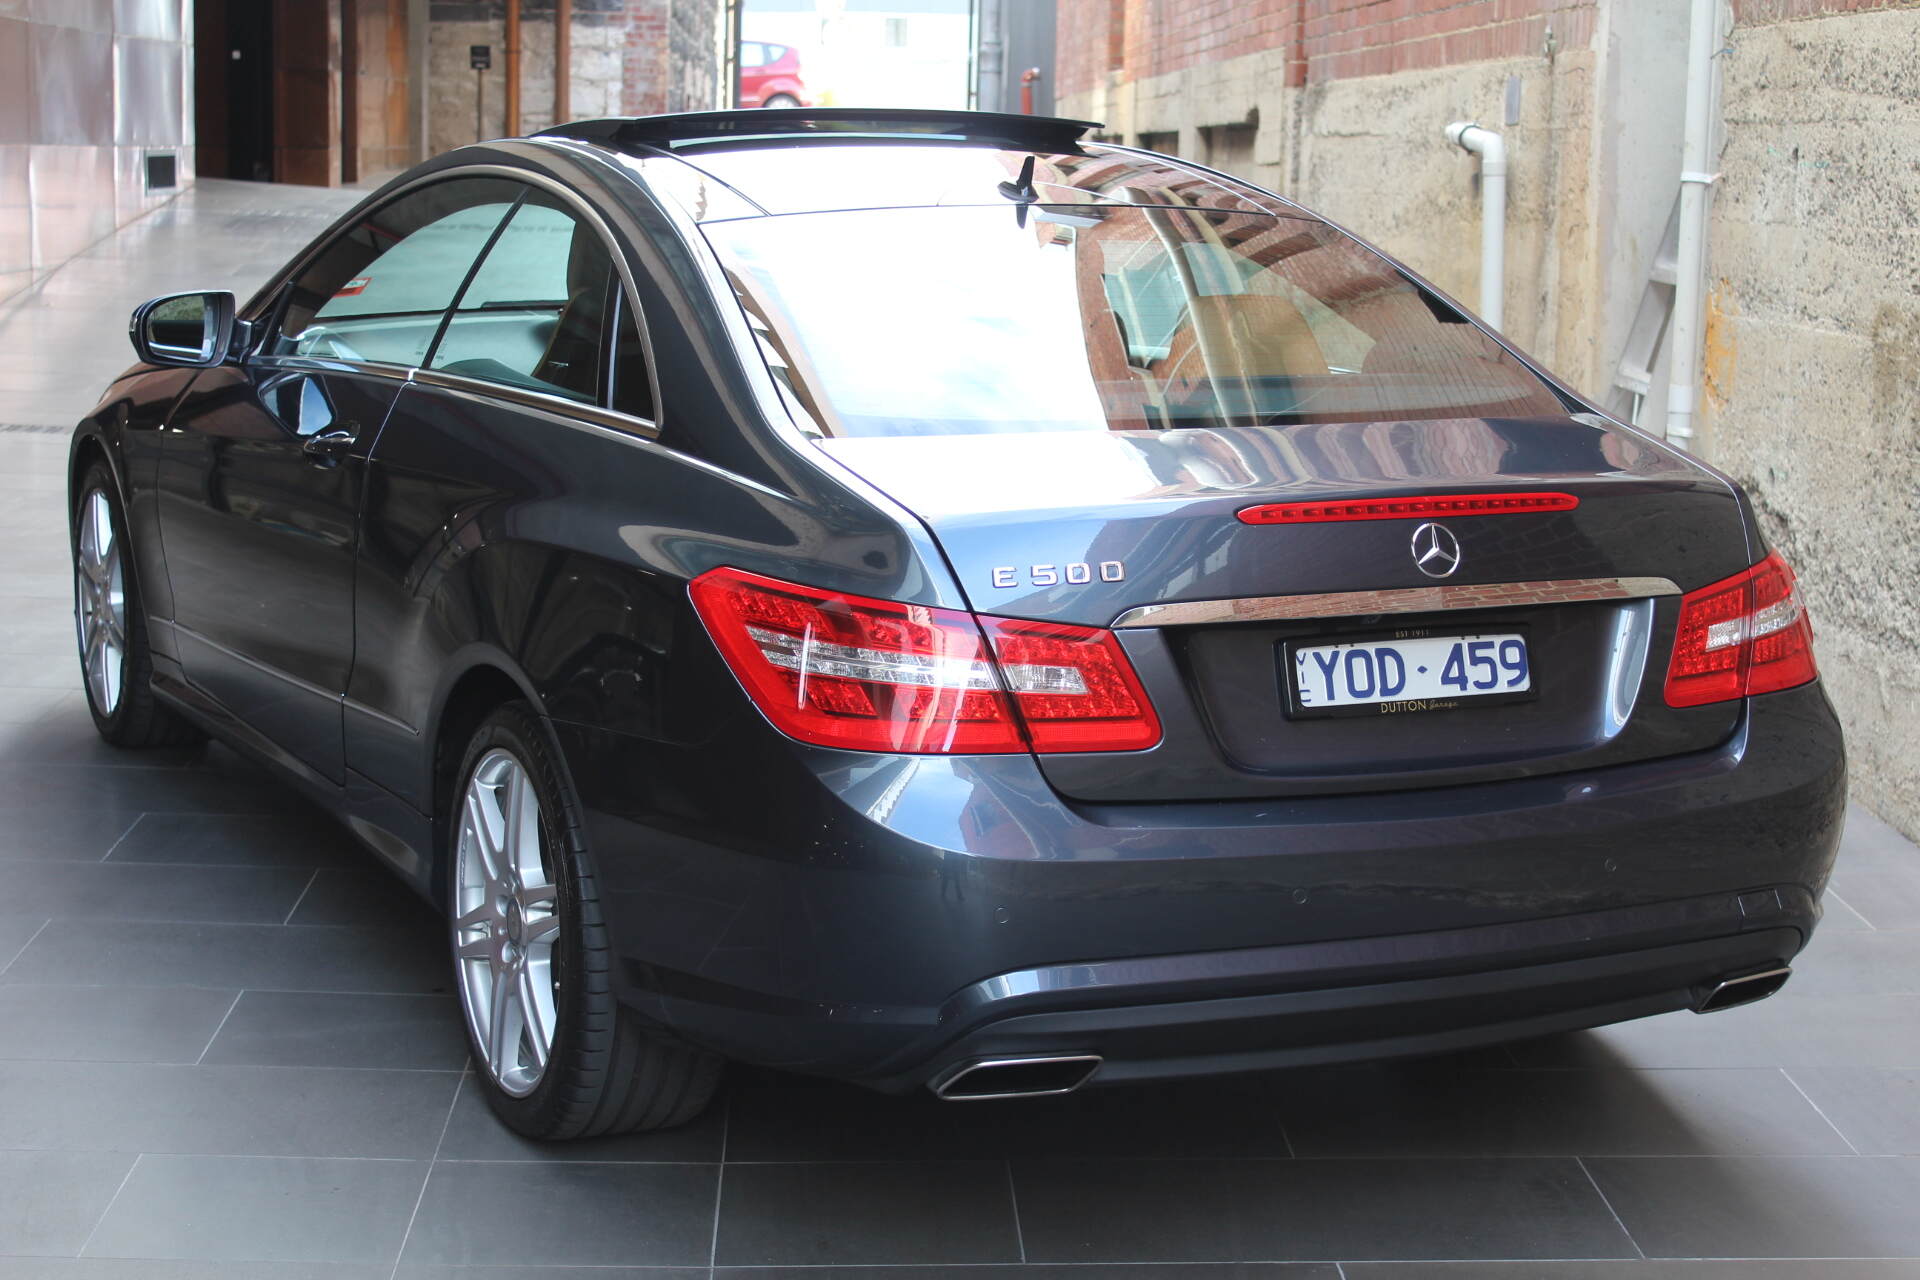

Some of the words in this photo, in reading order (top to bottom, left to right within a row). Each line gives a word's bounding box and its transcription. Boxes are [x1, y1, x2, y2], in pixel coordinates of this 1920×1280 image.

[992, 566, 1018, 588] E
[1031, 561, 1125, 587] 500
[1380, 699, 1427, 714] DUTTON
